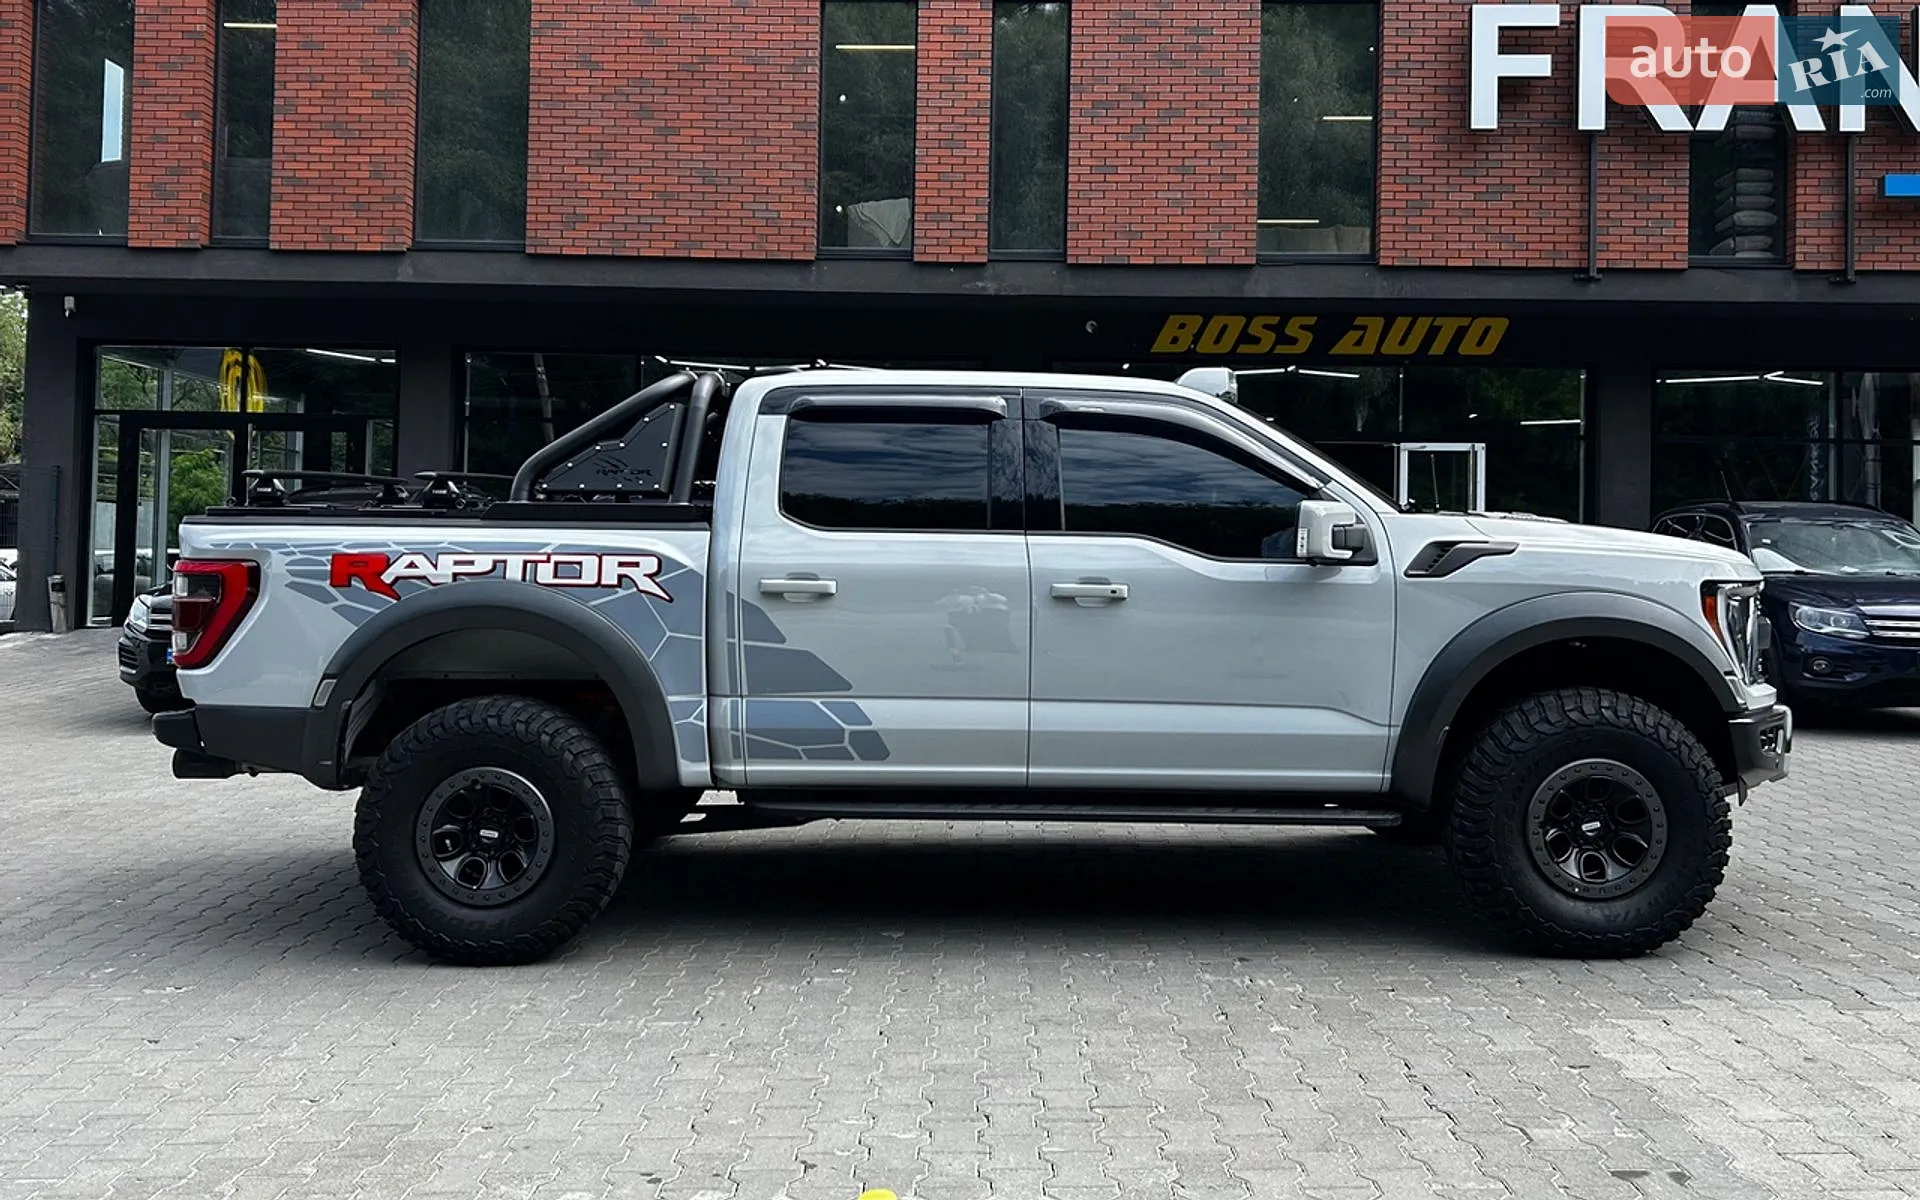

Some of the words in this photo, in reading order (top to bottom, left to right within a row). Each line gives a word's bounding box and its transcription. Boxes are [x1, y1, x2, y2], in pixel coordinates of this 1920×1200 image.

[1150, 315, 1318, 354] BOSS
[1328, 317, 1510, 356] AUTO
[329, 552, 675, 603] RAPTOR
